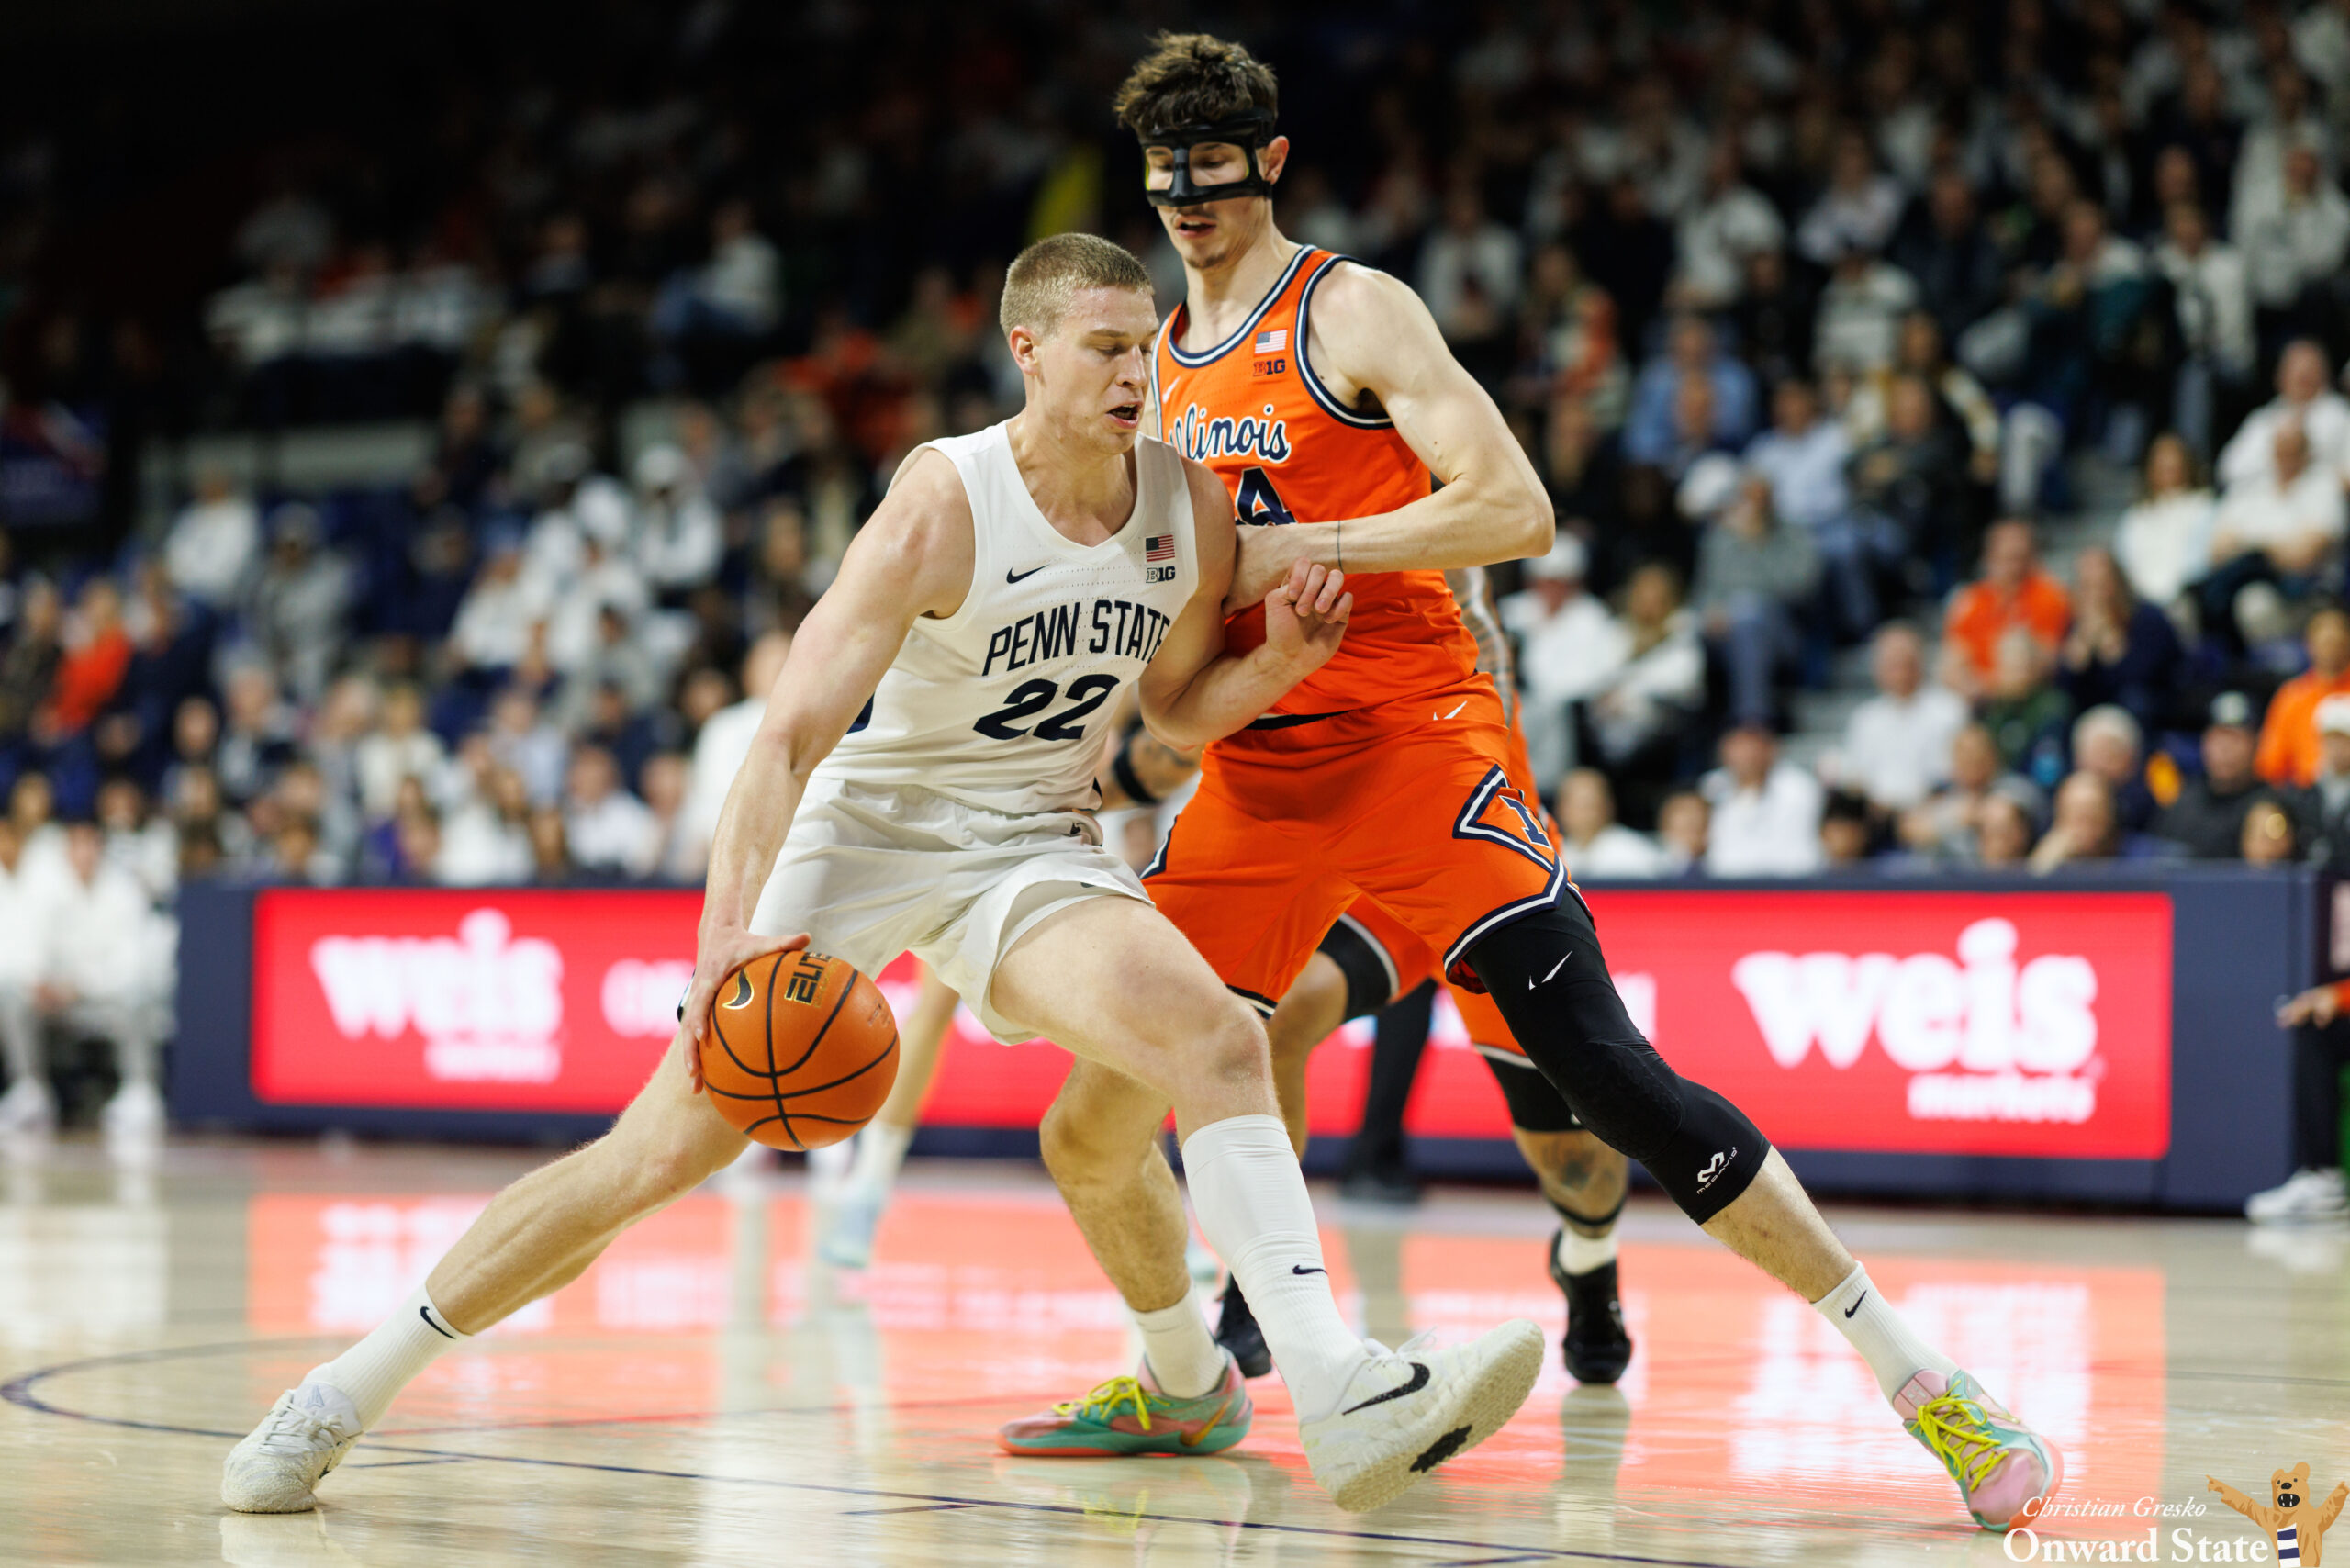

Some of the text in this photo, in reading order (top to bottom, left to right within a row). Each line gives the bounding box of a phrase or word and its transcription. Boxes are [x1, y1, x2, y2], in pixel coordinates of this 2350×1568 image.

[1169, 402, 1292, 464] llinois
[981, 601, 1081, 677] PENN
[973, 673, 1120, 741] 22
[1731, 917, 2098, 1071] weis
